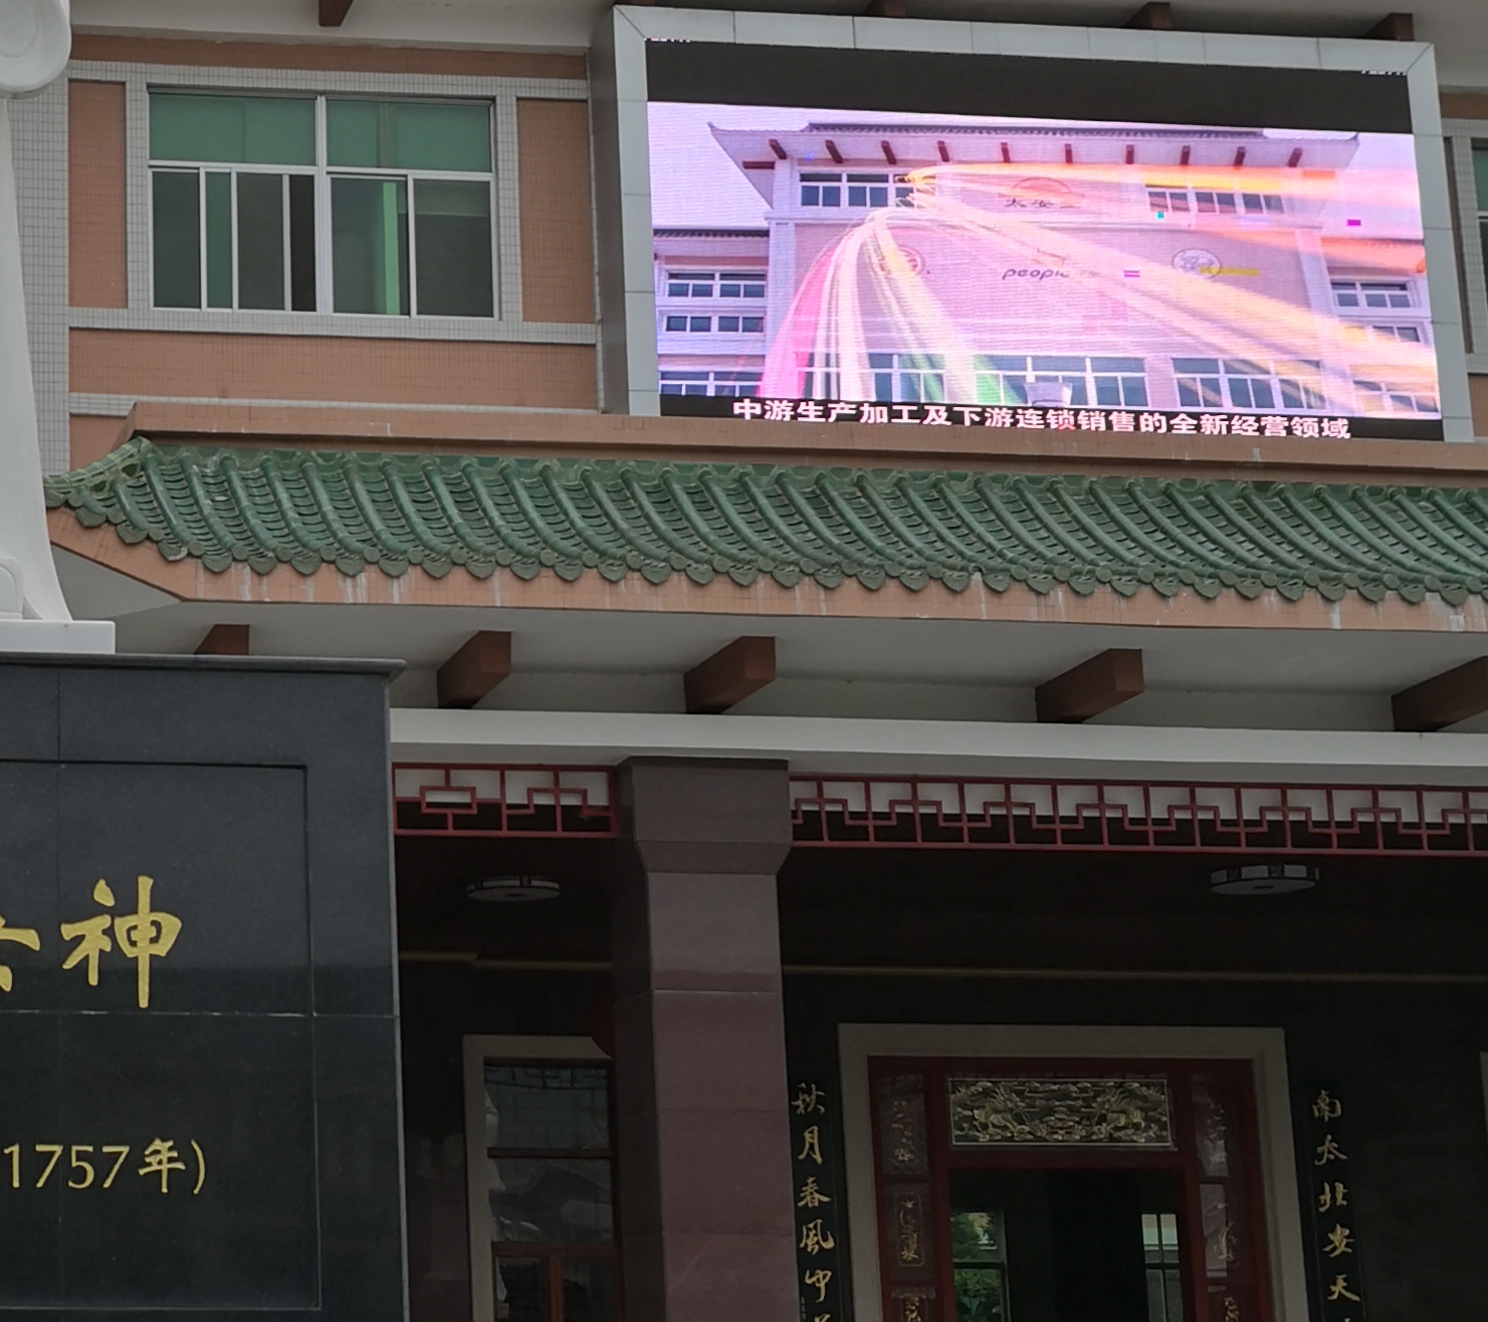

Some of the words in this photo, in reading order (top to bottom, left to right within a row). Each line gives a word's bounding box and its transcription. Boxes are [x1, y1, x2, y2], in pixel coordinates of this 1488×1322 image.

[732, 398, 1351, 439] 中游生产加工及下游连锁销售的全新经营领域
